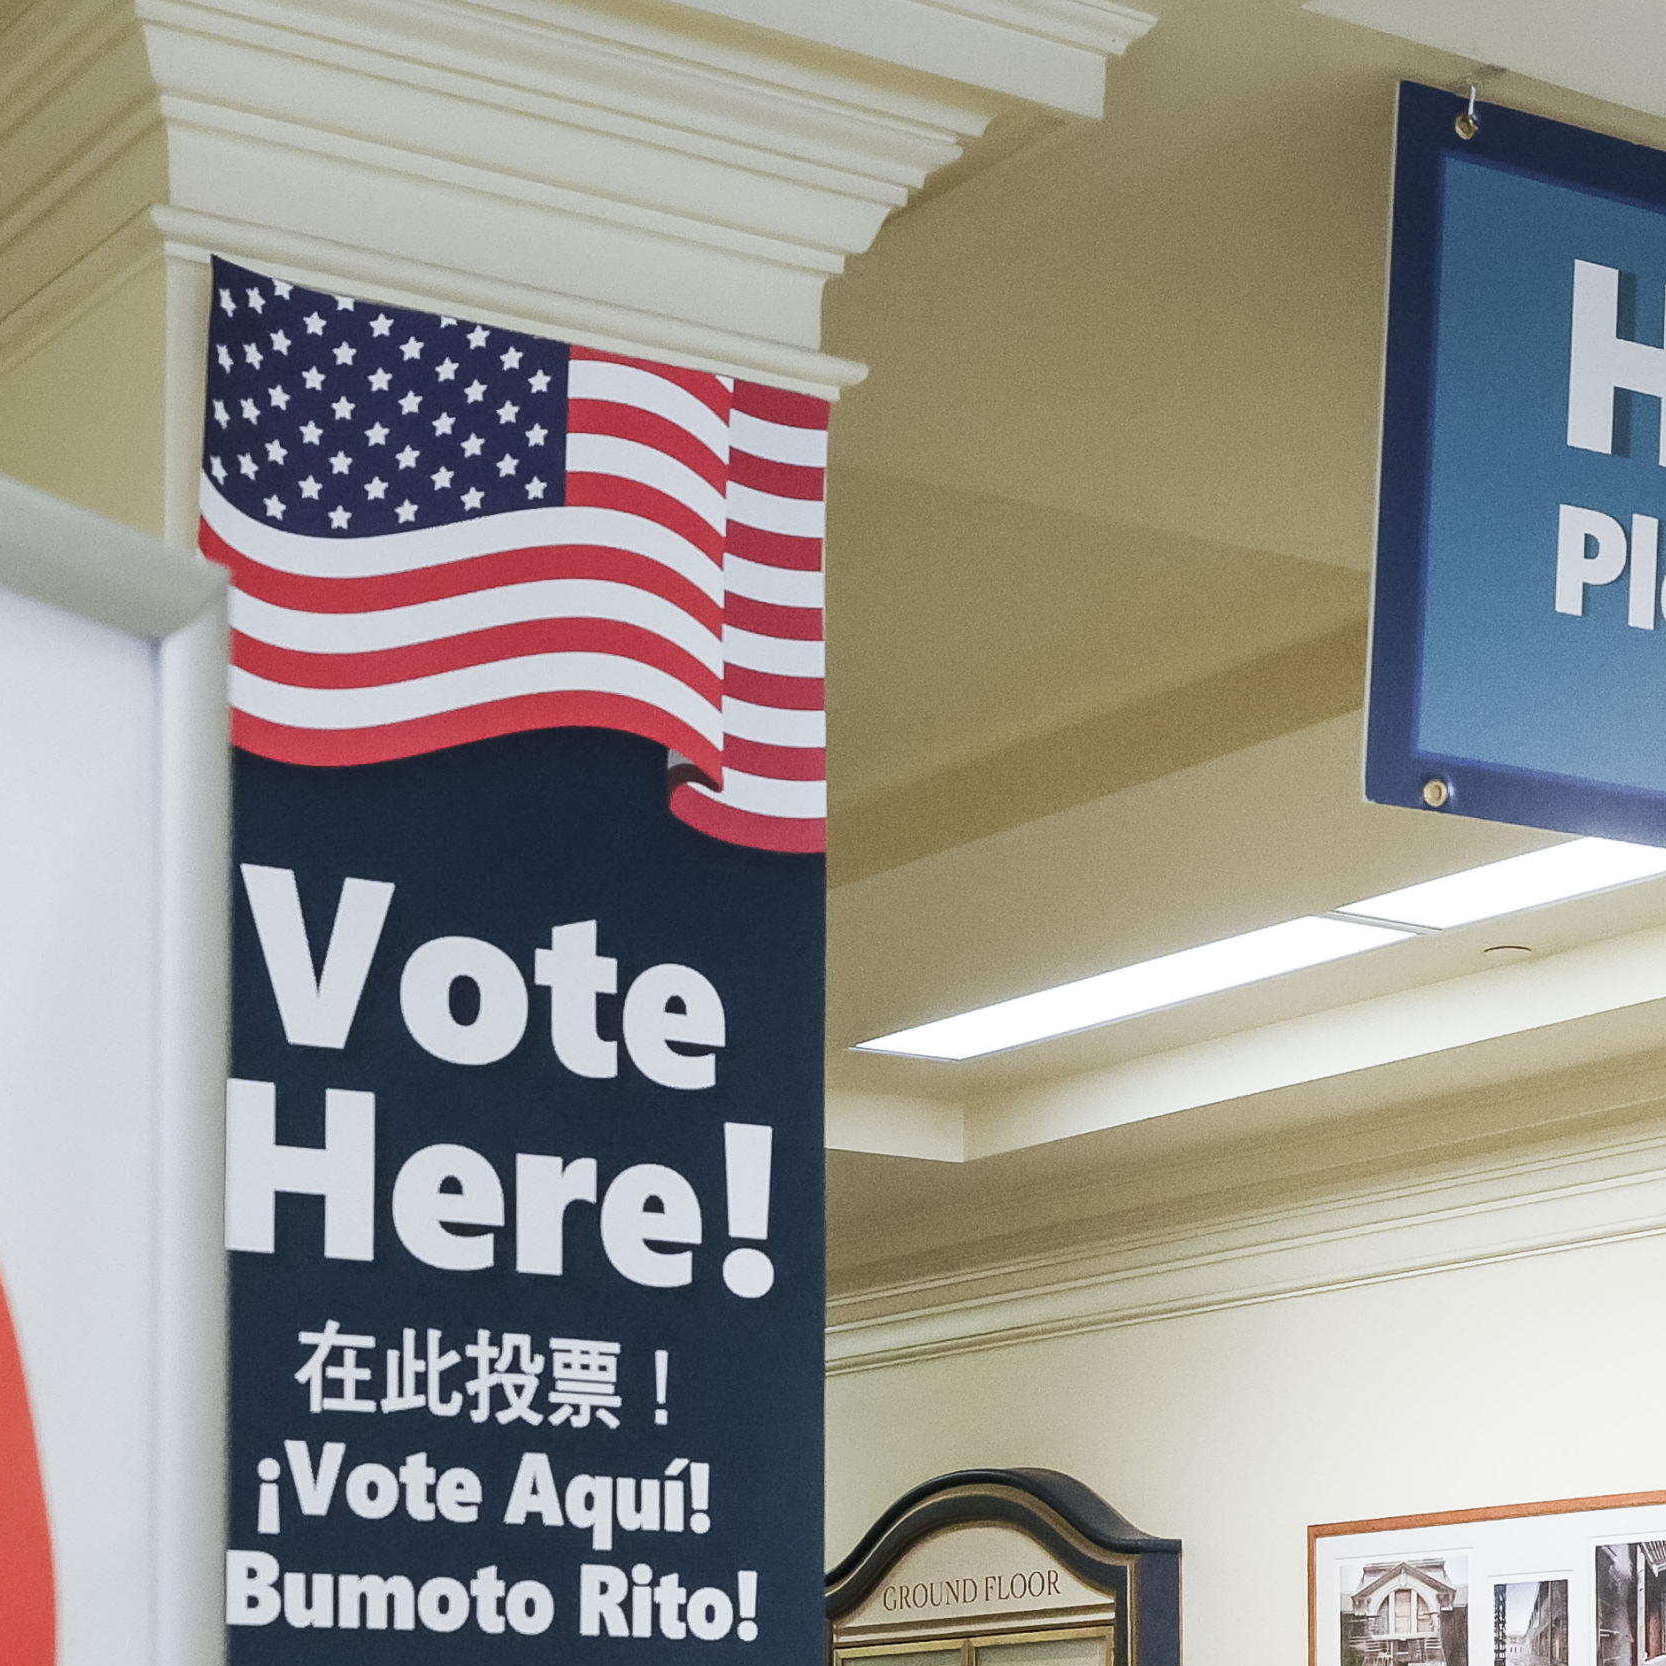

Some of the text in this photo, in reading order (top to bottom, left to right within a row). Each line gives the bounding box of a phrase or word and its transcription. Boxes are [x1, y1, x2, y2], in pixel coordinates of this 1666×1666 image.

[240, 863, 725, 1090] Vote
[225, 1077, 774, 1299] Here!
[295, 1320, 668, 1429] 在此投票！
[258, 1440, 710, 1550] ¡Vote Aquí!
[225, 1549, 758, 1641] Bumoto Rito!
[883, 1570, 1060, 1611] GROUND FLOOR
